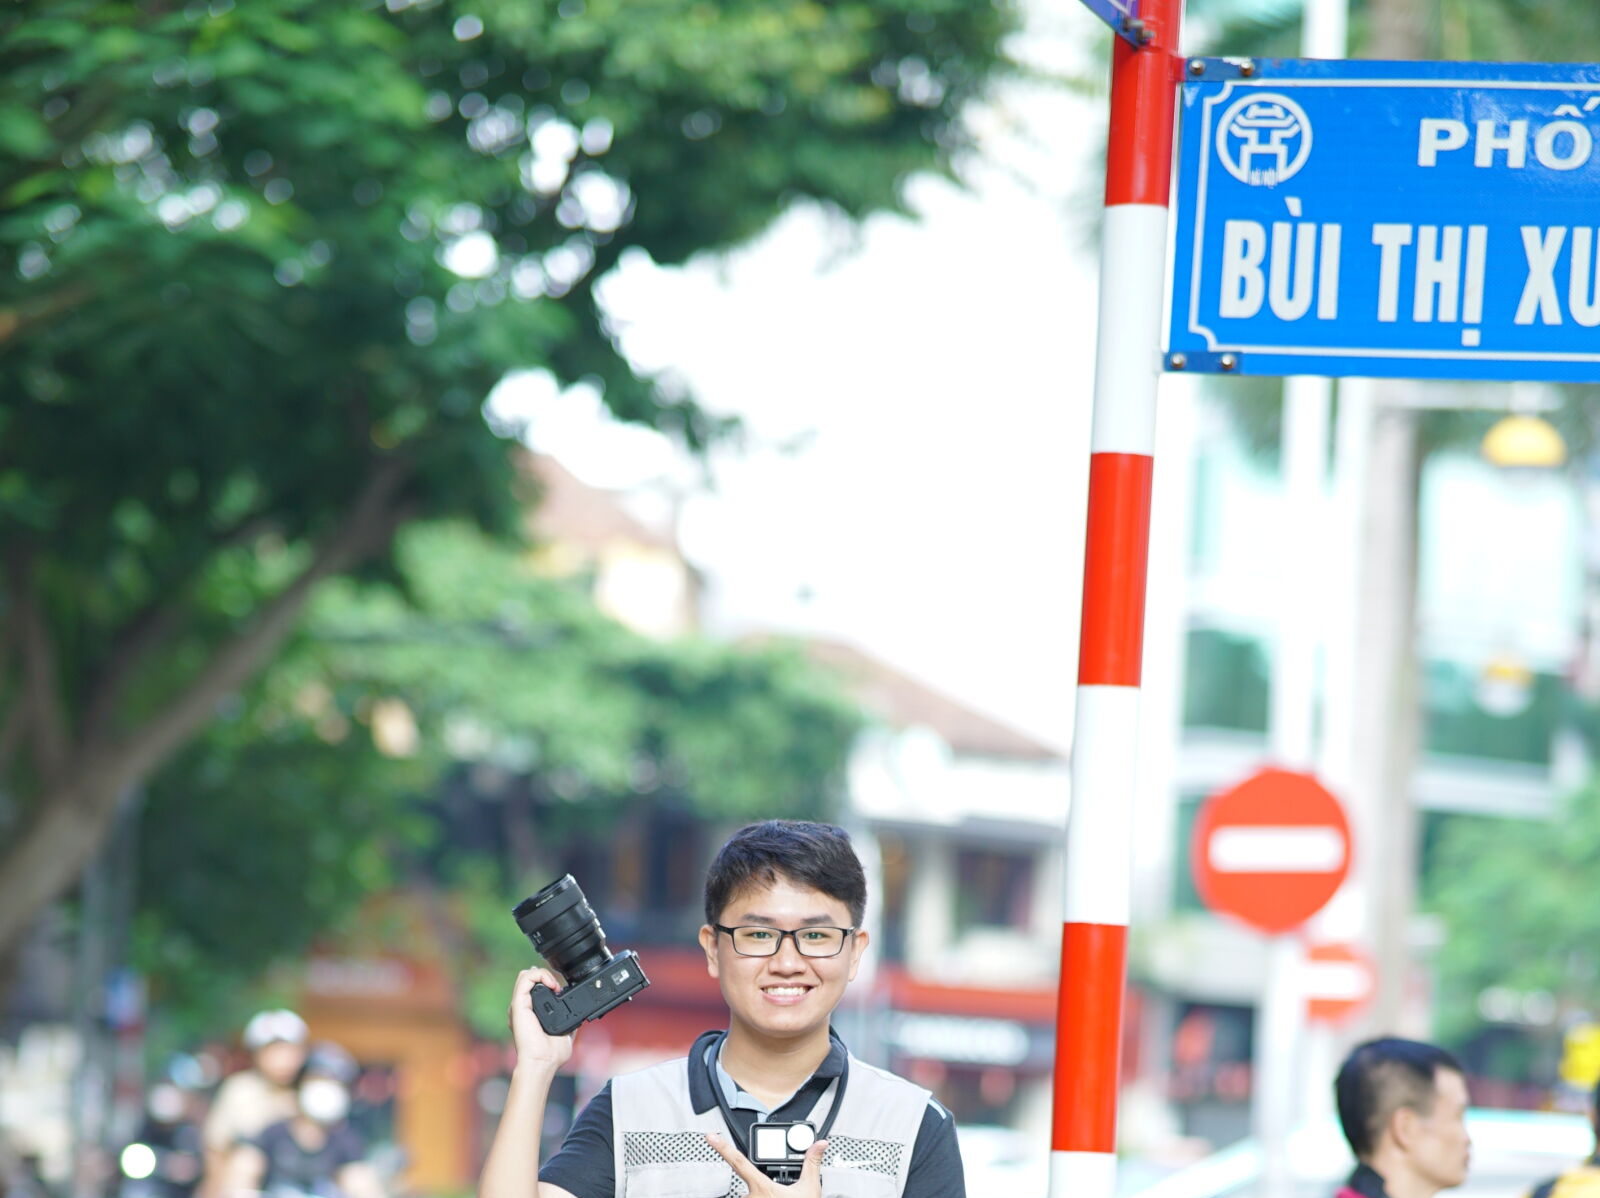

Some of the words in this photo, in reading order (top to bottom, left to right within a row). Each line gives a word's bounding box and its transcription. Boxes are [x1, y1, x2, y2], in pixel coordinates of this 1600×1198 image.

[1418, 96, 1600, 171] PHỐ
[1219, 197, 1341, 321] BÙI
[1372, 223, 1488, 346] THỊ
